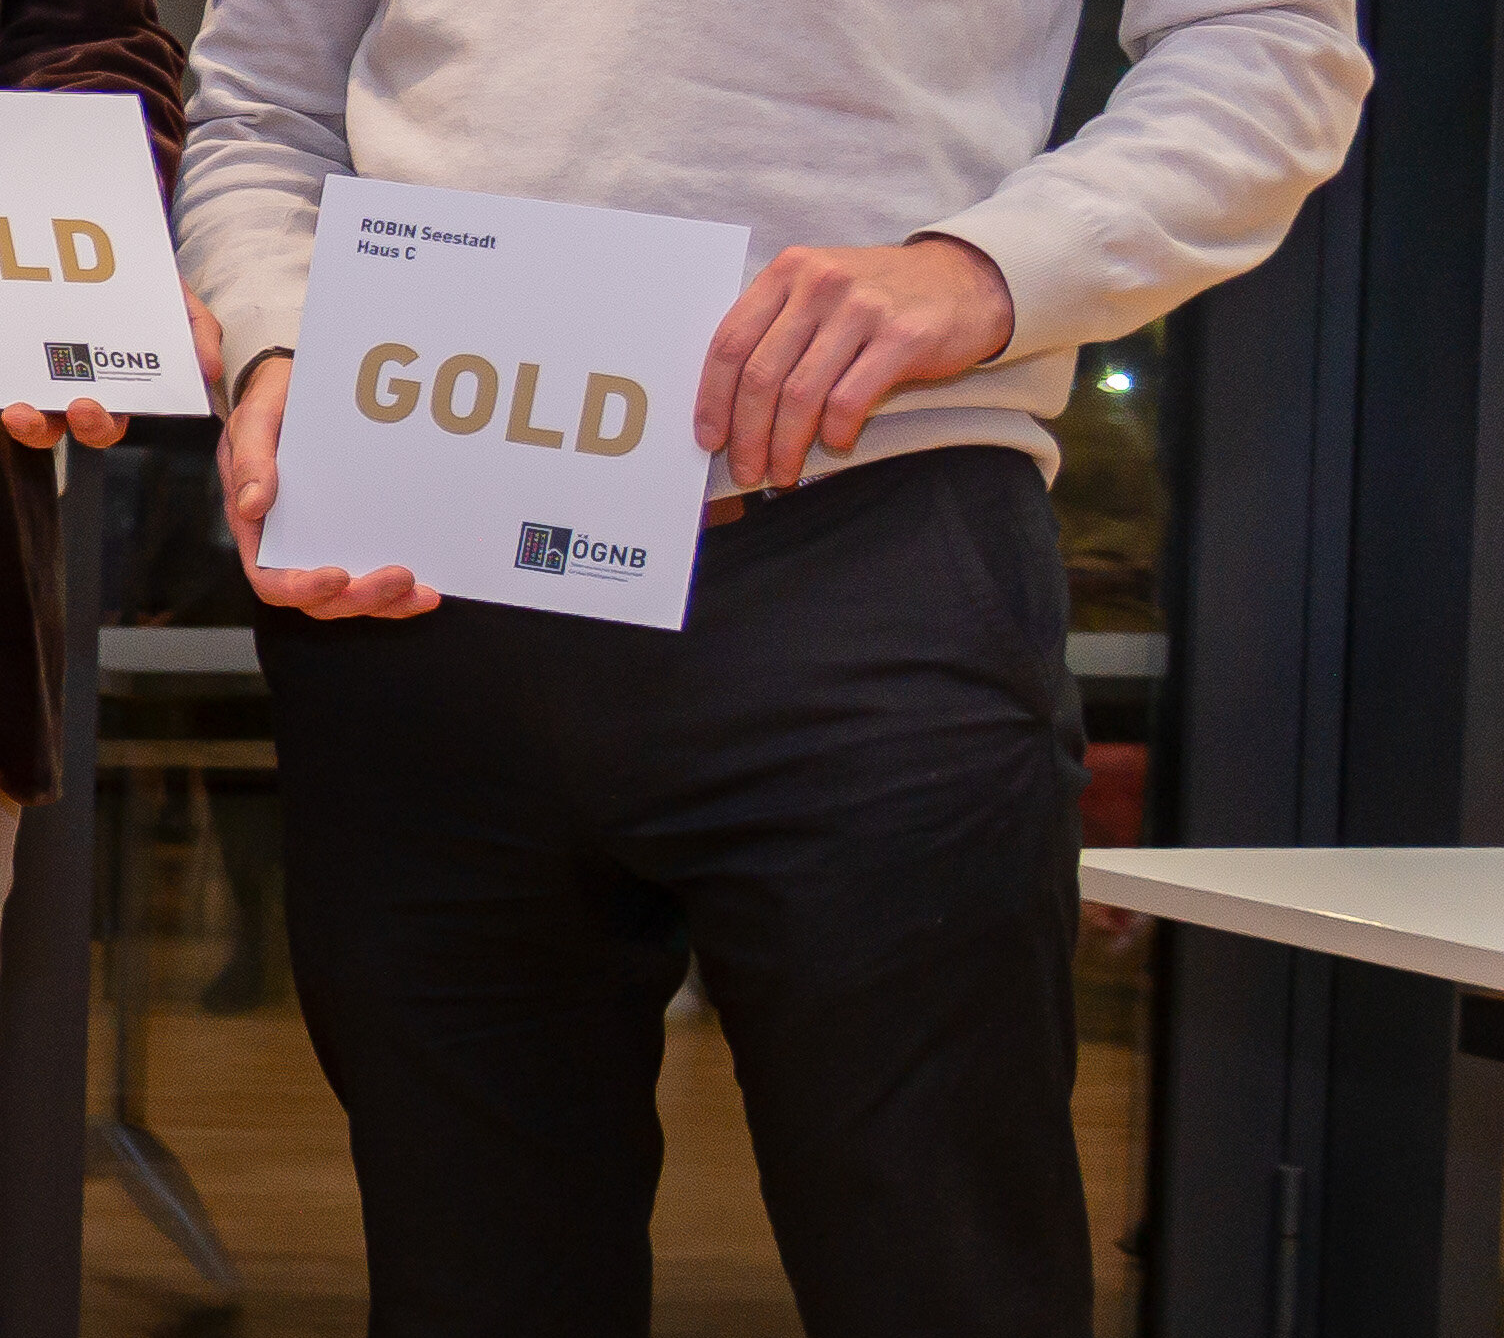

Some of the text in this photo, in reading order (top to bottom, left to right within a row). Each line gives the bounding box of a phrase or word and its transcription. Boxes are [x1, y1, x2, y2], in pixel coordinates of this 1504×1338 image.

[360, 218, 497, 249] ROBIN Seestadt
[357, 239, 416, 260] Haus C
[94, 346, 161, 370] ÖGNB
[354, 342, 648, 458] GOLD
[572, 533, 647, 569] ÖGNB
